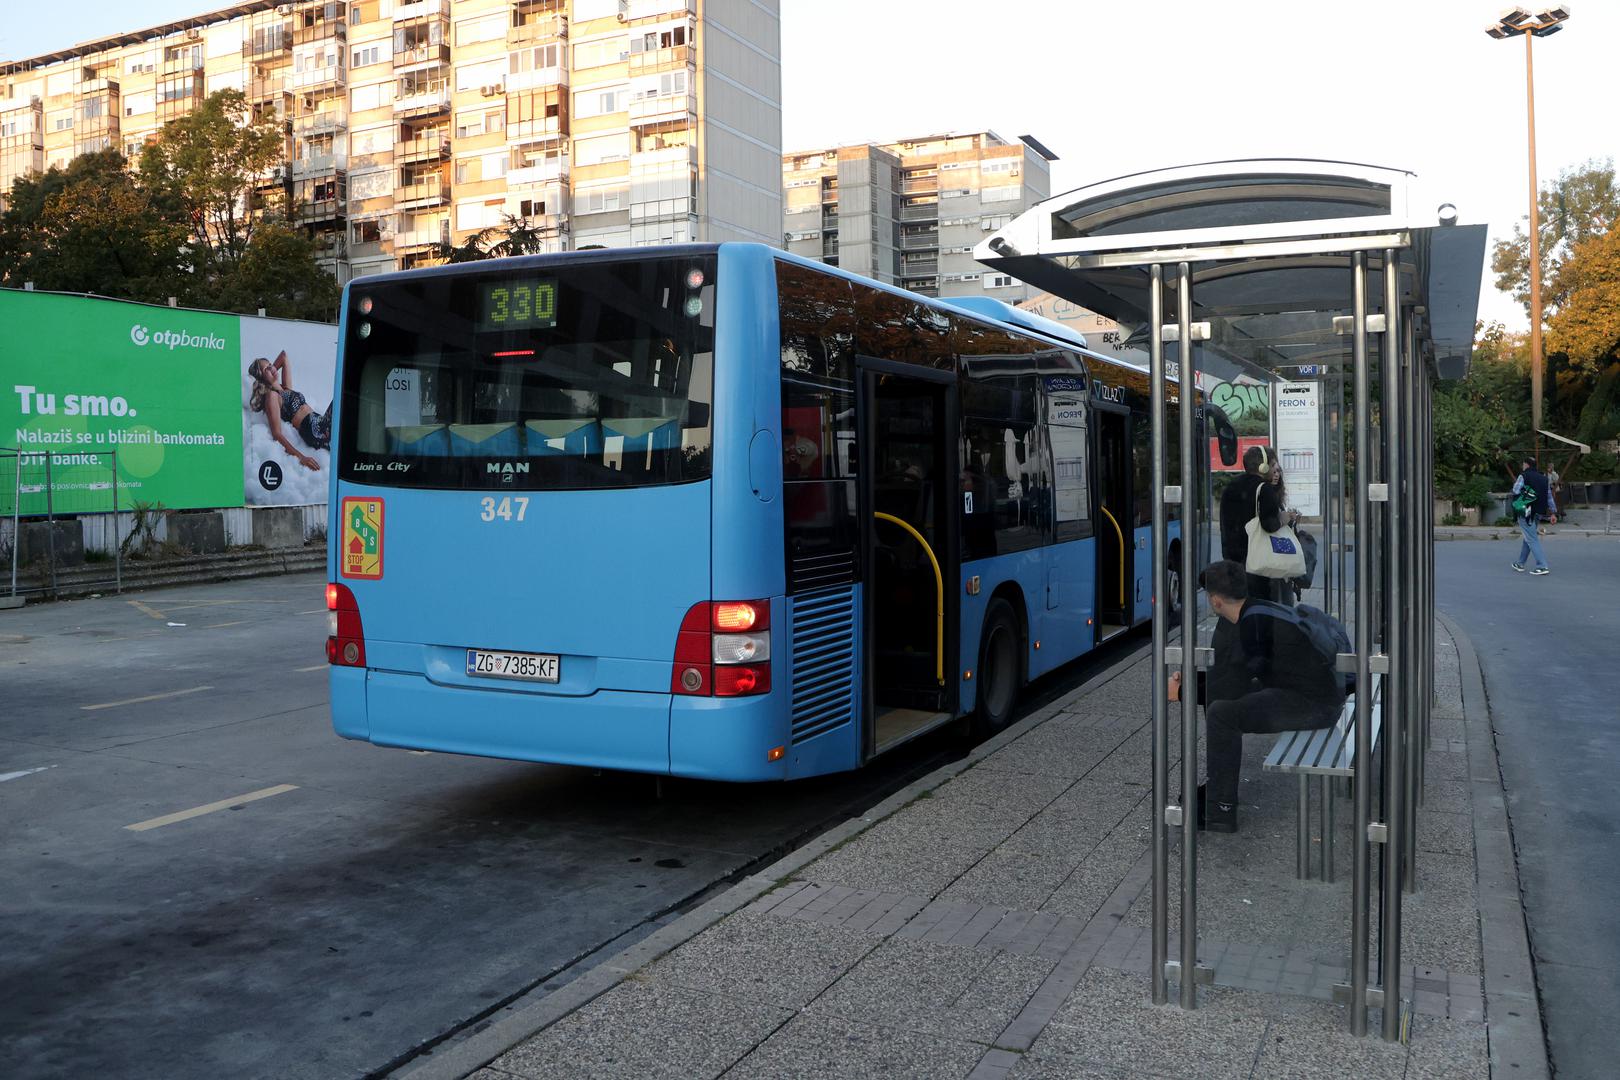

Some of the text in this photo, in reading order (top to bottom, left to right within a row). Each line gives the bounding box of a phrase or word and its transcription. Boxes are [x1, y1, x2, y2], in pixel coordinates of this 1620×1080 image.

[491, 284, 554, 322] 330
[153, 328, 225, 350] otpbanka
[15, 385, 137, 417] Tu smo.
[1102, 385, 1119, 402] IZLAZ
[1278, 399, 1306, 407] PERON
[16, 428, 225, 446] Nalaziš se u blizini bankomata
[52, 451, 102, 465] banke.
[353, 461, 411, 473] Lion's City
[487, 462, 530, 473] MAN
[480, 497, 529, 522] 347
[355, 518, 375, 546] BUS
[347, 554, 364, 565] STOP
[477, 654, 494, 672] ZG
